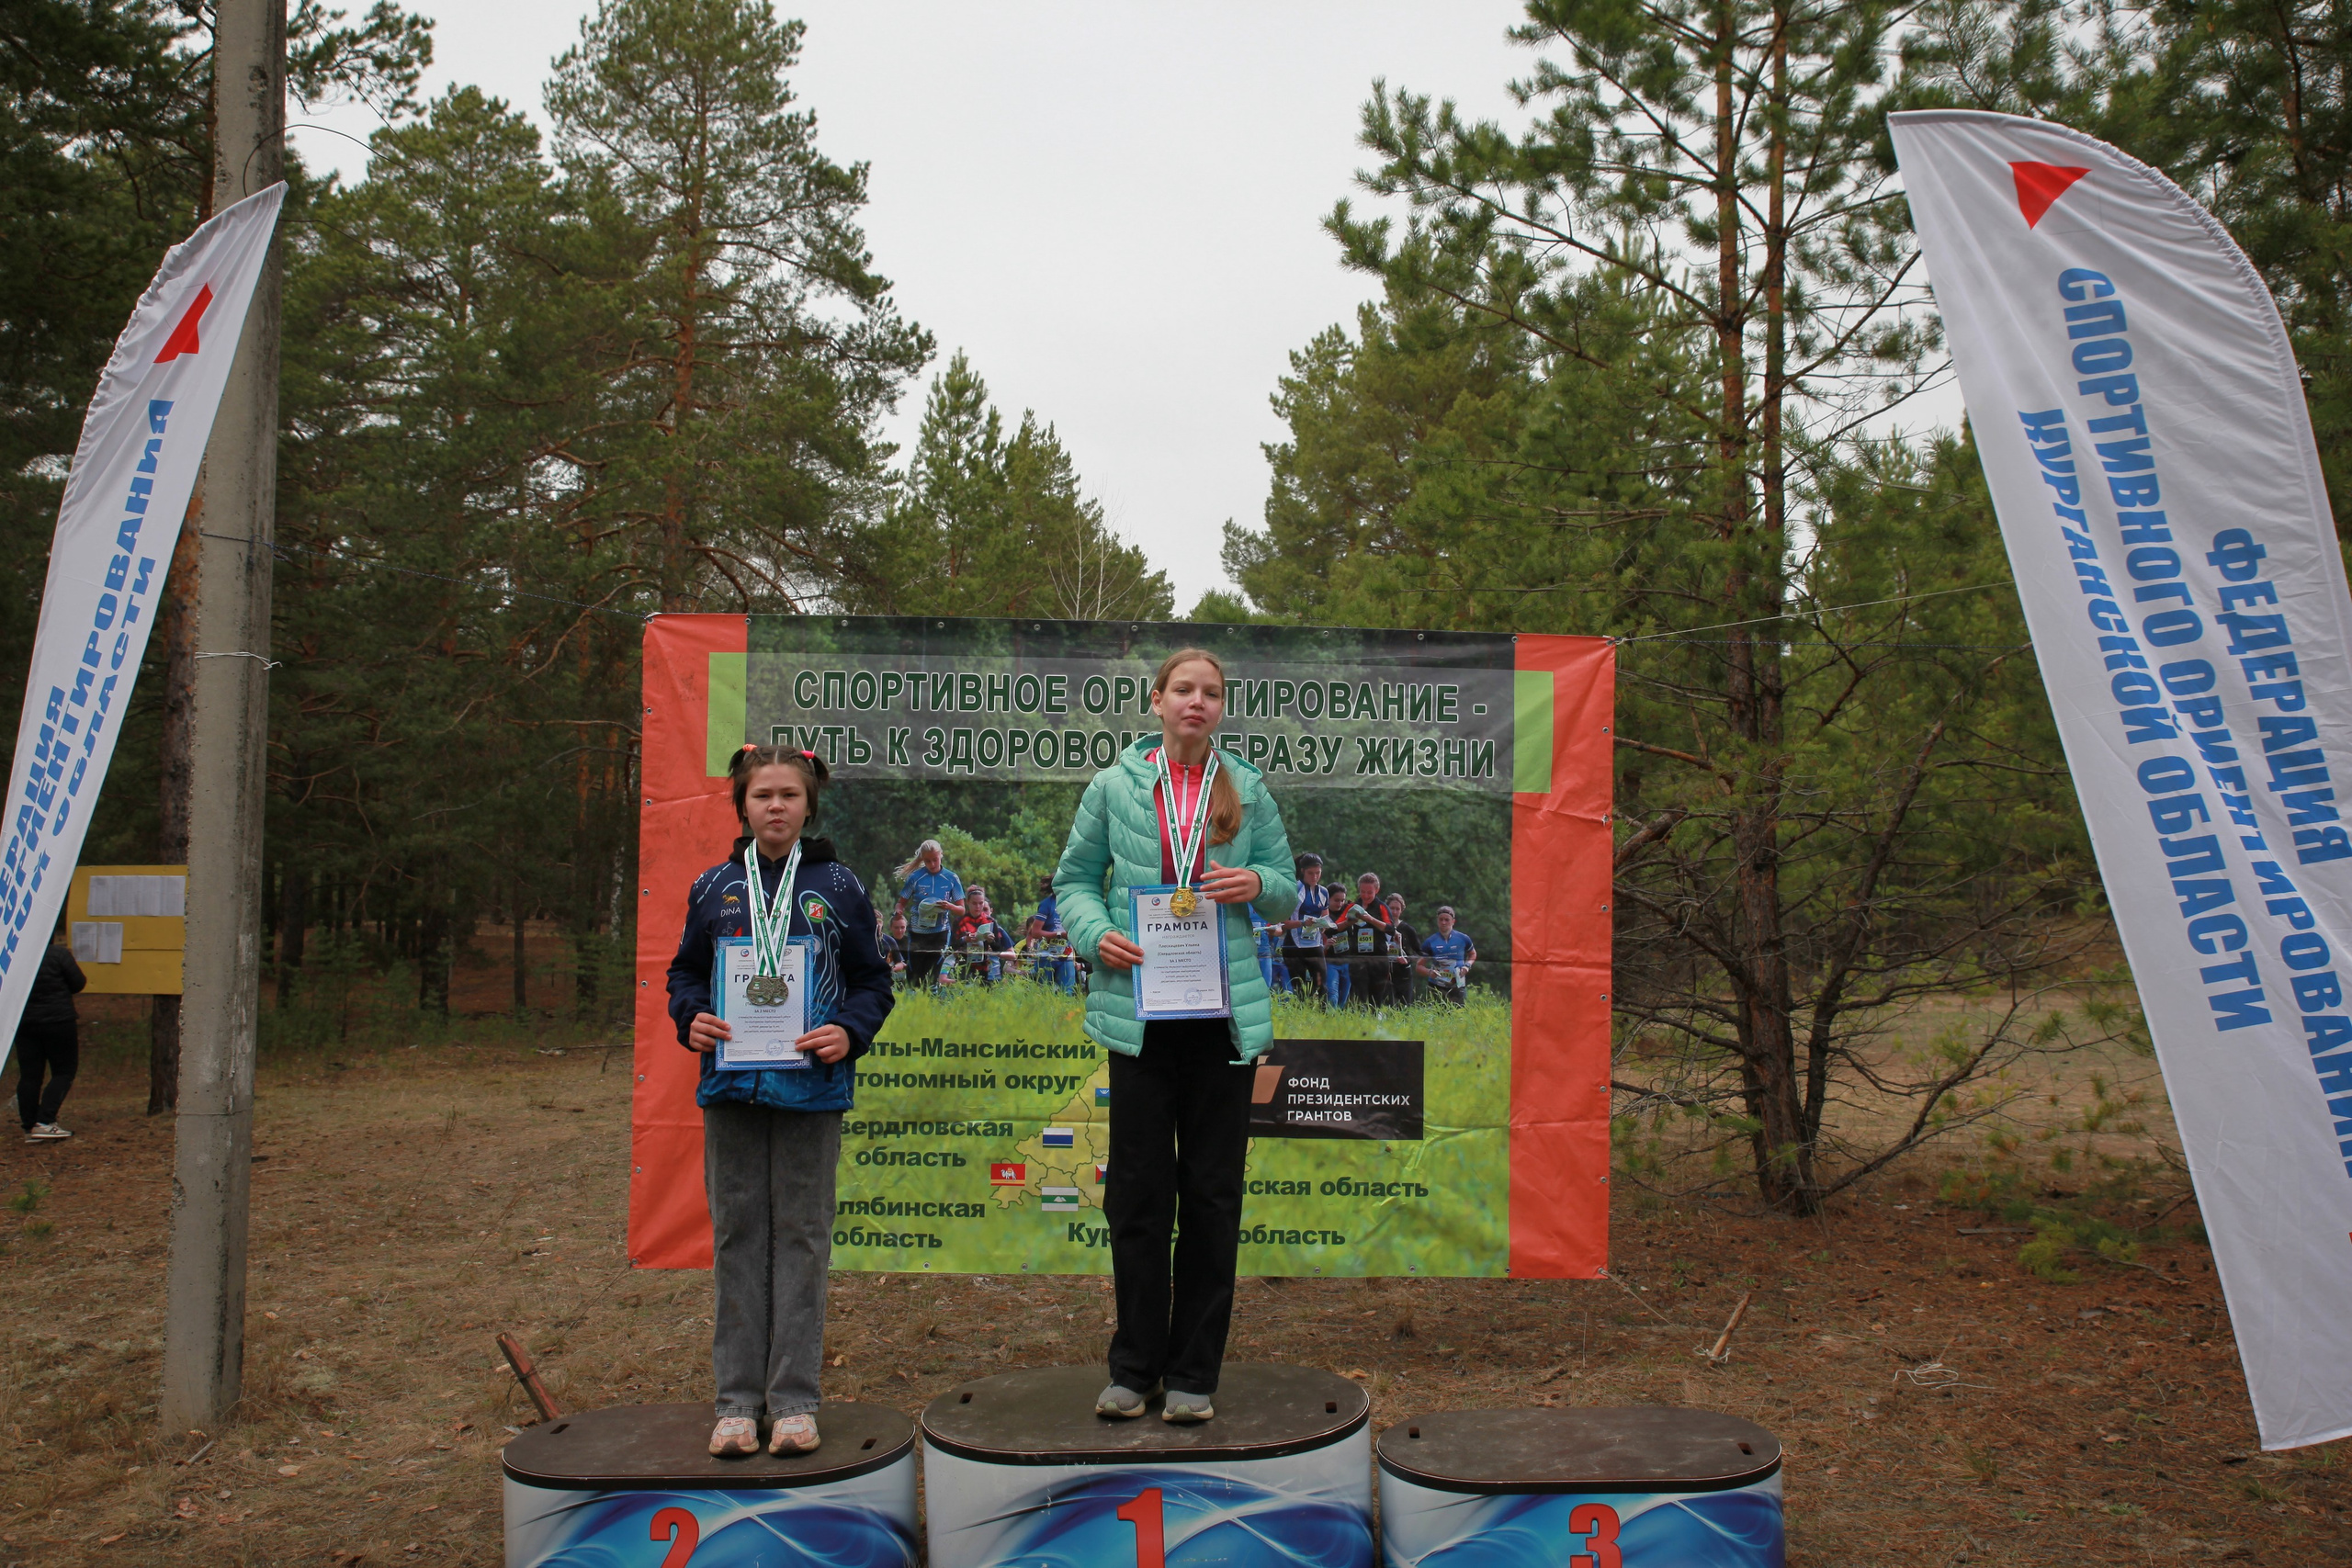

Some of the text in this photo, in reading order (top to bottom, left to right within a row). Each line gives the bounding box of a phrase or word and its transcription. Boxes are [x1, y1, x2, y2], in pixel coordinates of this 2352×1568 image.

[2058, 267, 2203, 648] СПОРТИВНОГО
[53, 557, 156, 837] ОБЛАСТИ
[793, 670, 1068, 714] СПОРТИВНОЕ
[1082, 674, 1459, 723] ОРИТИРОВАНИЕ
[2206, 527, 2352, 865] ФЕДЕРАЦИЯ
[2018, 408, 2273, 1032] КУРГАНСКОЙ ОБЛАСТИ
[887, 727, 910, 765] К
[1208, 732, 1343, 774] БРАЗУ
[1355, 736, 1495, 778] ЖИЗНИ
[720, 907, 741, 918] DINA
[1147, 920, 1208, 932] ГРАМОТА
[855, 1068, 1081, 1094] тономный округ
[1287, 1077, 1330, 1089] ФОНД
[1287, 1094, 1410, 1106] ПРЕЗИДЕНТСКИХ
[1287, 1111, 1352, 1122] ГРАНТОВ
[841, 1120, 1013, 1140] вердловская
[855, 1145, 967, 1167] область
[1319, 1177, 1429, 1197] область
[837, 1196, 985, 1217] лябинская
[832, 1226, 943, 1248] область
[1238, 1224, 1346, 1245] область
[650, 1506, 700, 1568] 2
[1116, 1487, 1166, 1568] 1
[1569, 1502, 1623, 1568] 3
